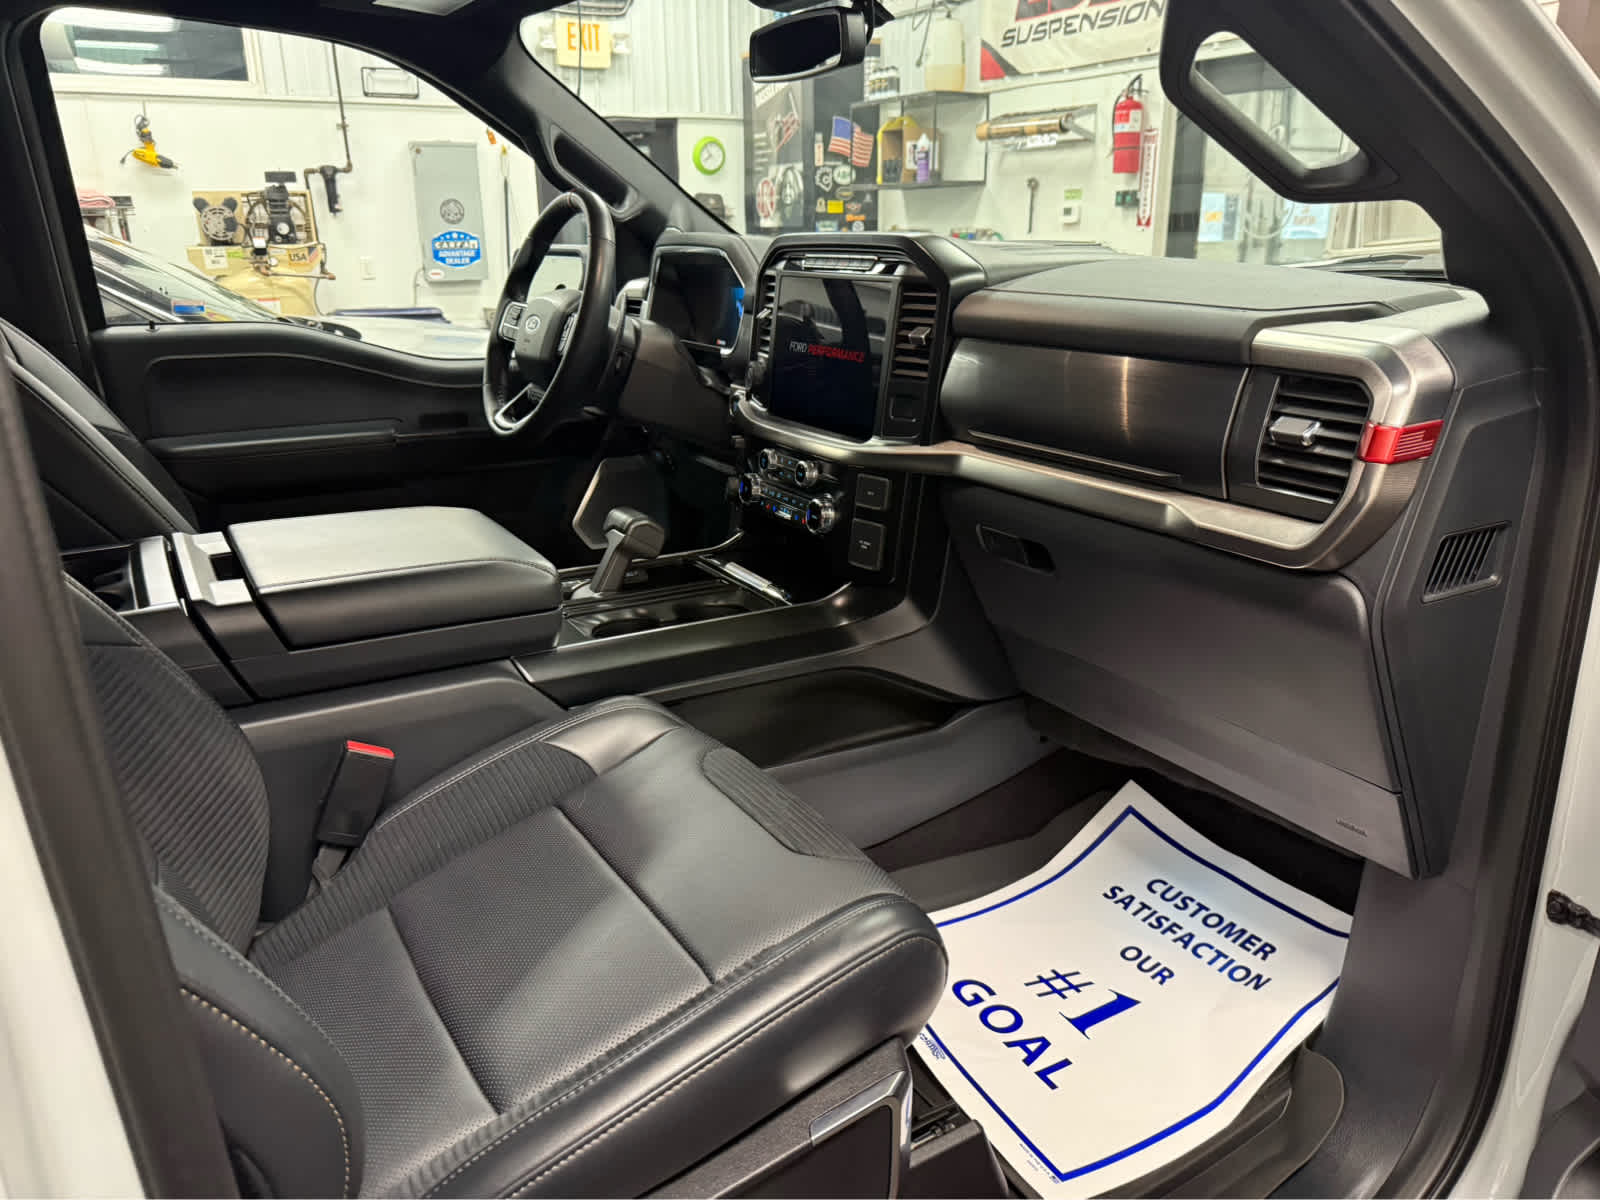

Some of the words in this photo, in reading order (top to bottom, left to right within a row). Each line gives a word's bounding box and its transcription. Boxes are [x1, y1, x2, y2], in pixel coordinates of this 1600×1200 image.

[567, 22, 600, 51] EXIT
[1001, 0, 1165, 48] SUSPENSION
[289, 252, 307, 261] USA
[789, 340, 808, 353] FORD
[808, 343, 865, 363] PERFORMANCE
[1102, 885, 1272, 991] SATISFACTION
[1146, 878, 1277, 961] CUSTOMER
[1119, 945, 1175, 985] OUR
[1023, 968, 1142, 1040] #1
[951, 979, 1073, 1091] GOAL
